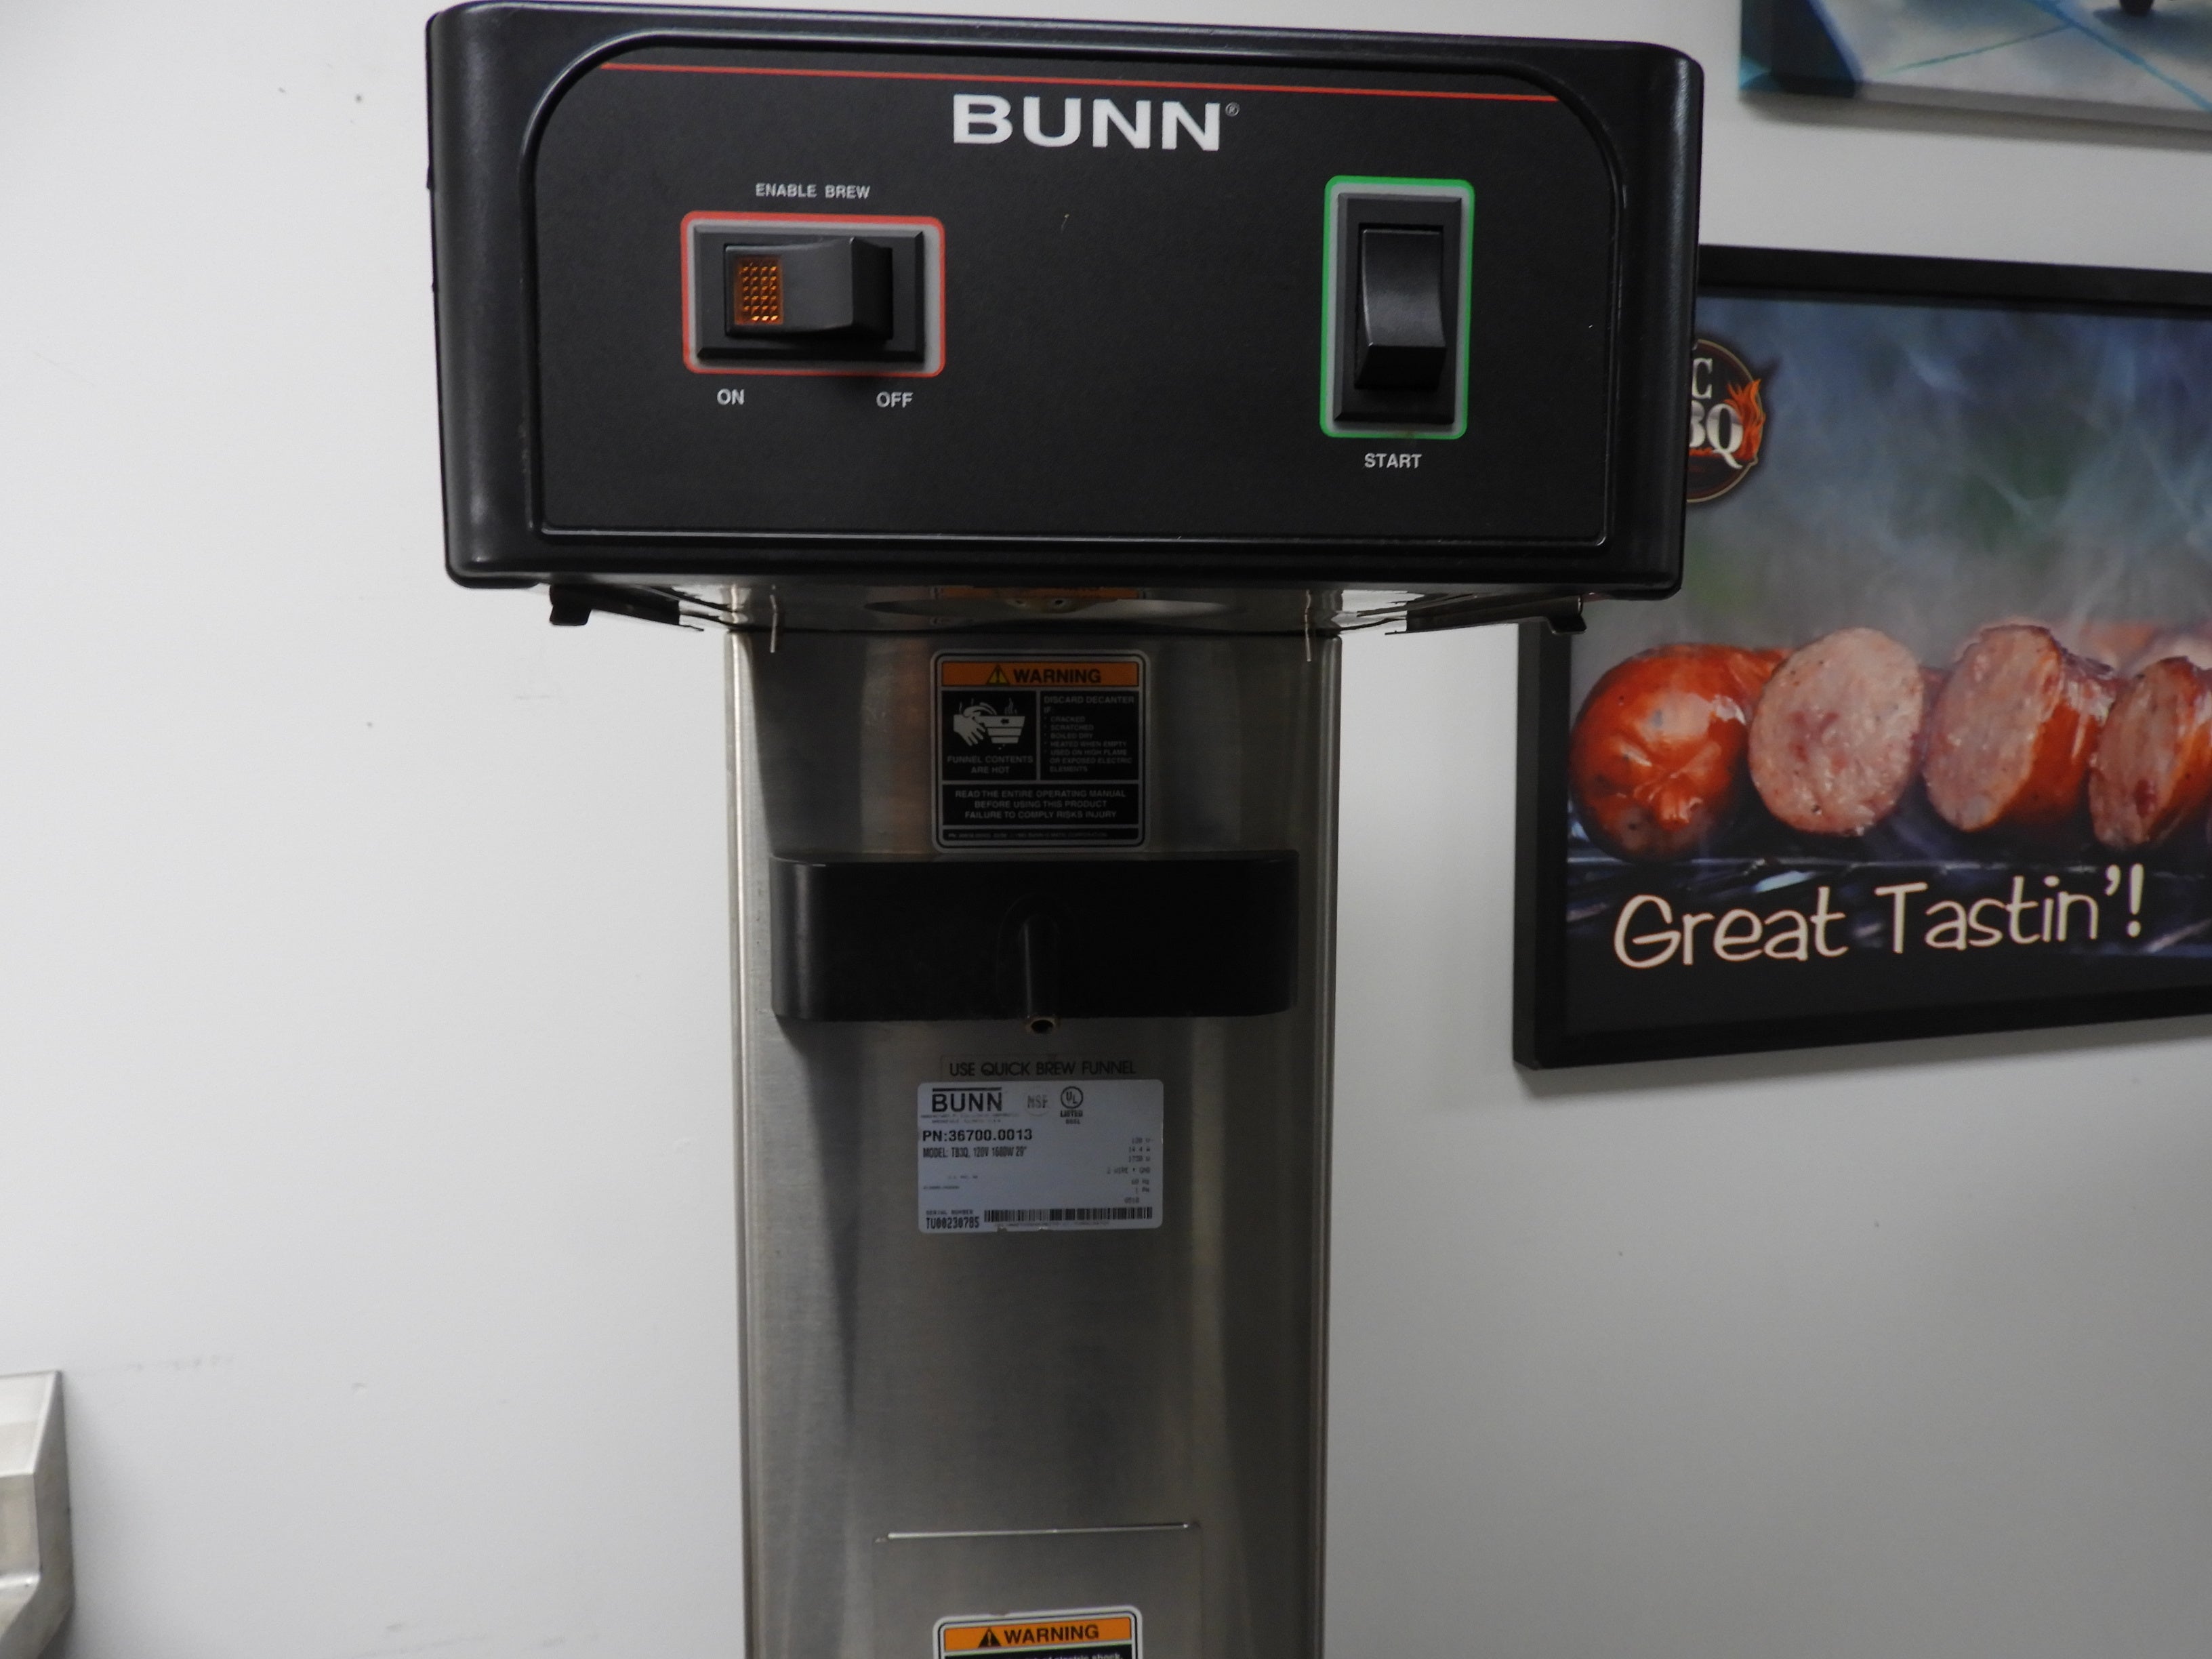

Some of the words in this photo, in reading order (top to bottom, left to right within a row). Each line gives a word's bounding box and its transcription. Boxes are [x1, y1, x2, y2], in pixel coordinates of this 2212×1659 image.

[755, 183, 817, 198] ENABLE
[825, 184, 871, 199] BREW
[716, 389, 745, 406] ON
[876, 390, 913, 409] OFF
[1364, 453, 1421, 470] START
[1014, 669, 1101, 683] WARNING
[1614, 886, 1847, 969] Great
[950, 1063, 975, 1076] USE
[981, 1063, 1029, 1076] QUICK
[1037, 1062, 1075, 1075] BREW
[1082, 1061, 1136, 1073] FUNNEL
[932, 1093, 1002, 1112] BUNN
[922, 1129, 1032, 1141] PN:36700.0013
[924, 1149, 948, 1158] MODEL:
[1004, 1624, 1099, 1644] WARNING
